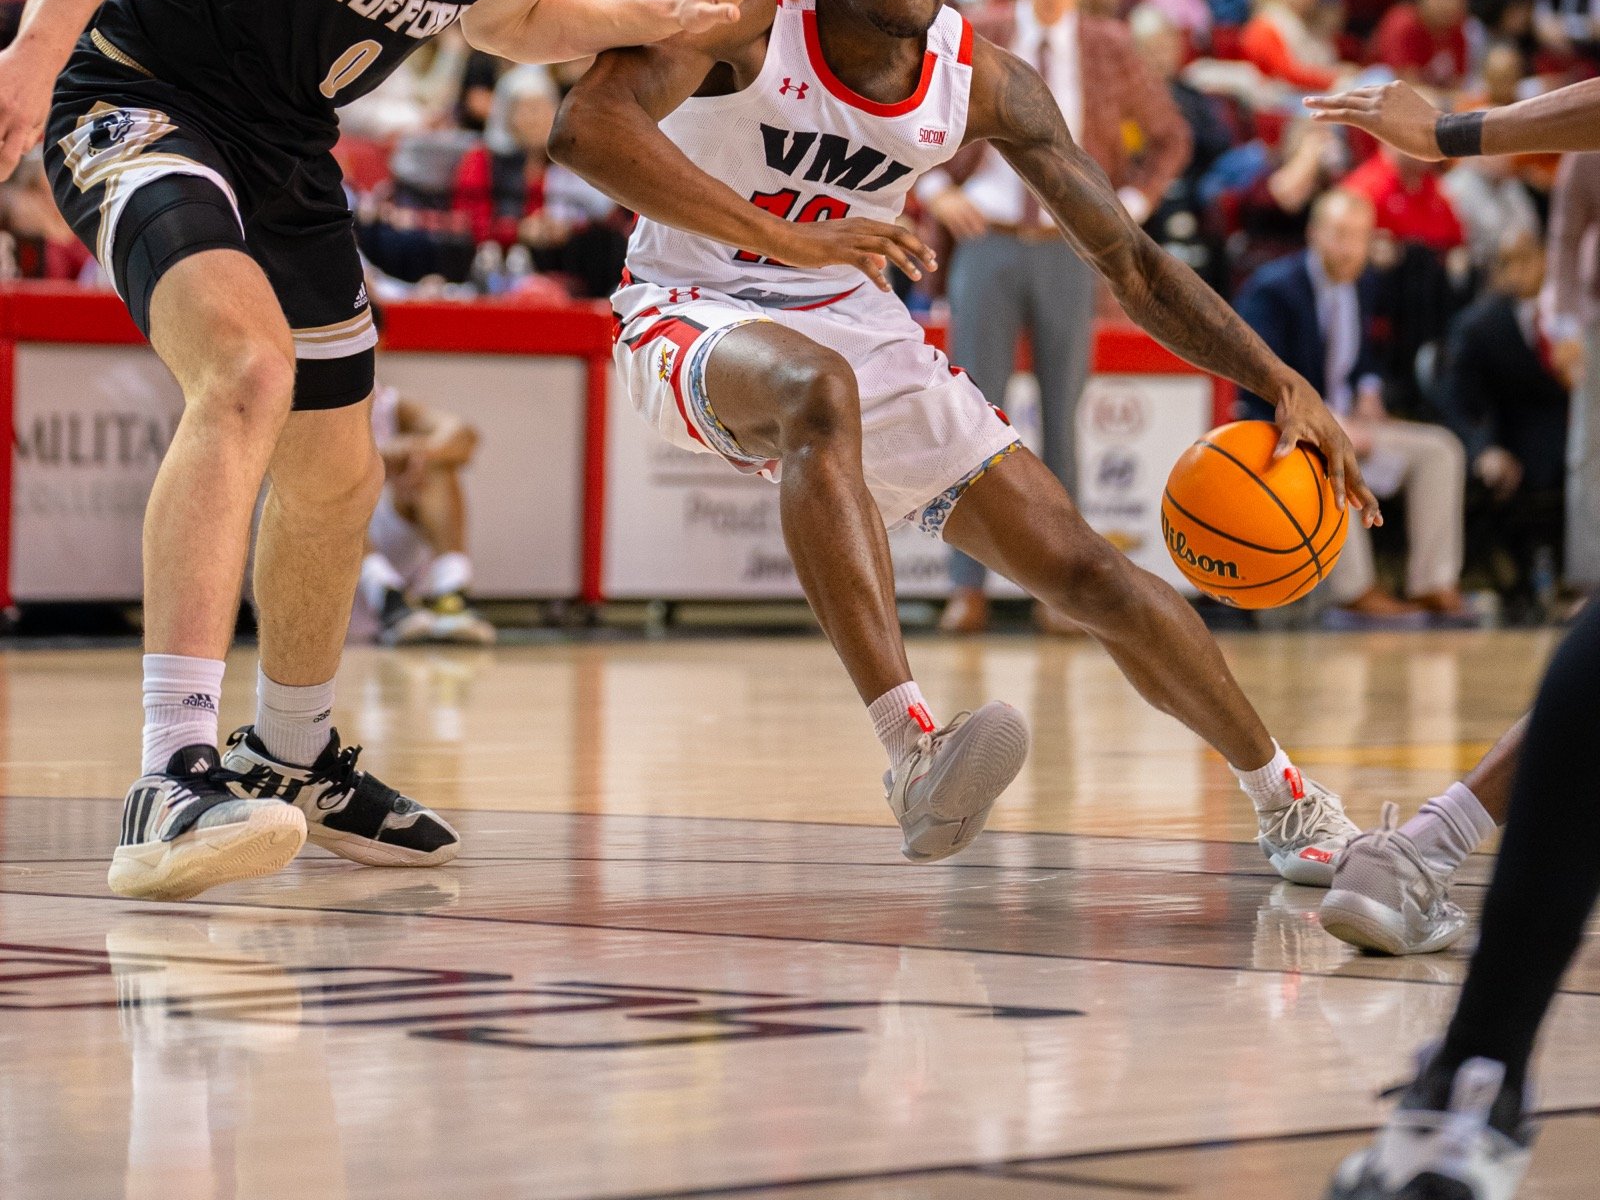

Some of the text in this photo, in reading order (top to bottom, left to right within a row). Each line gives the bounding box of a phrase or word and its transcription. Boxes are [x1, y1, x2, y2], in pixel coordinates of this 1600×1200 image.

[319, 39, 383, 98] 0
[760, 123, 914, 192] VMI
[919, 128, 947, 145] SOCON
[12, 412, 186, 467] MILITA
